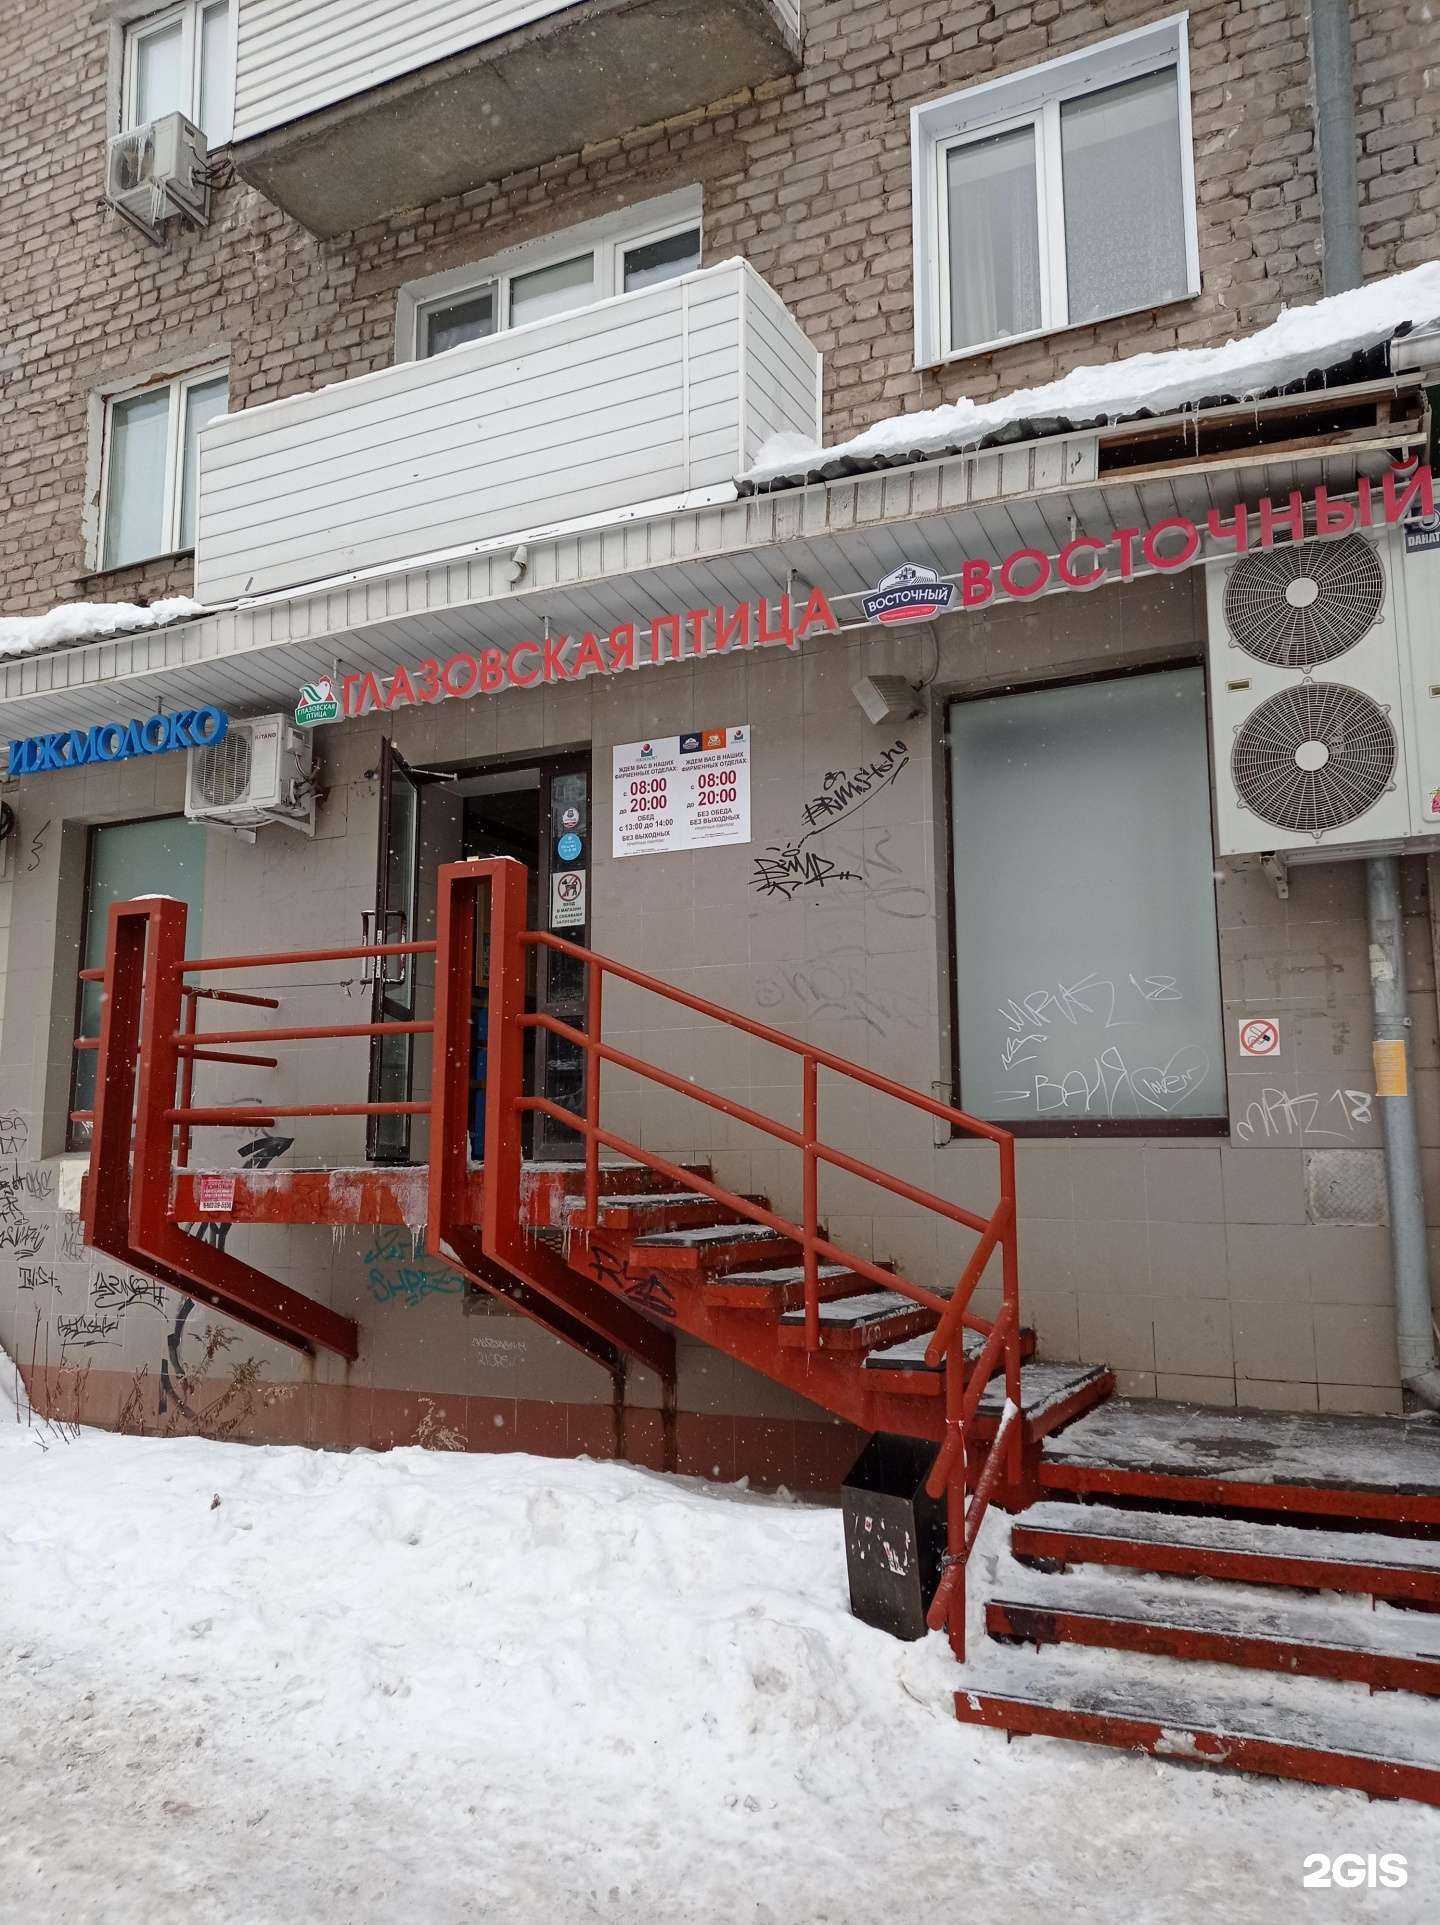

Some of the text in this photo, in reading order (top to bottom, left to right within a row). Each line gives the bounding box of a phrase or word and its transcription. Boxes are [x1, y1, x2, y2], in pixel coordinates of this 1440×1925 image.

[962, 455, 1434, 606] ВОСТОЧНЫЙ
[867, 586, 949, 612] ВОСТОЧНЫЙ
[341, 586, 840, 717] ГЛАЗОВСКАЯ ПТИЦА
[297, 703, 336, 715] ГЛАЗОВСКАЯ
[306, 711, 328, 720] ПТИЦА
[8, 706, 228, 774] ИЖМОЛОКО
[704, 755, 716, 764] ВАС
[721, 751, 744, 760] НАШИХ
[719, 758, 747, 767] ОТДЕЛАХ
[636, 763, 648, 771] ВАС
[651, 766, 677, 775] ОТДЕЛАХ
[698, 770, 737, 789] 08:00
[630, 778, 667, 796] 08:00
[698, 787, 737, 807] 20:00
[630, 795, 667, 813] 20:00
[637, 813, 655, 822] ОБЕД
[697, 808, 732, 818] БЕЗ ОБЕДА
[625, 822, 643, 831] 13:00
[644, 822, 655, 831] до
[655, 818, 674, 827] 14:00
[689, 818, 702, 827] БЕЗ
[702, 814, 740, 825] ВЫХОДНЫХ
[622, 830, 670, 841] БЕЗ ВЫХОДНЫХ
